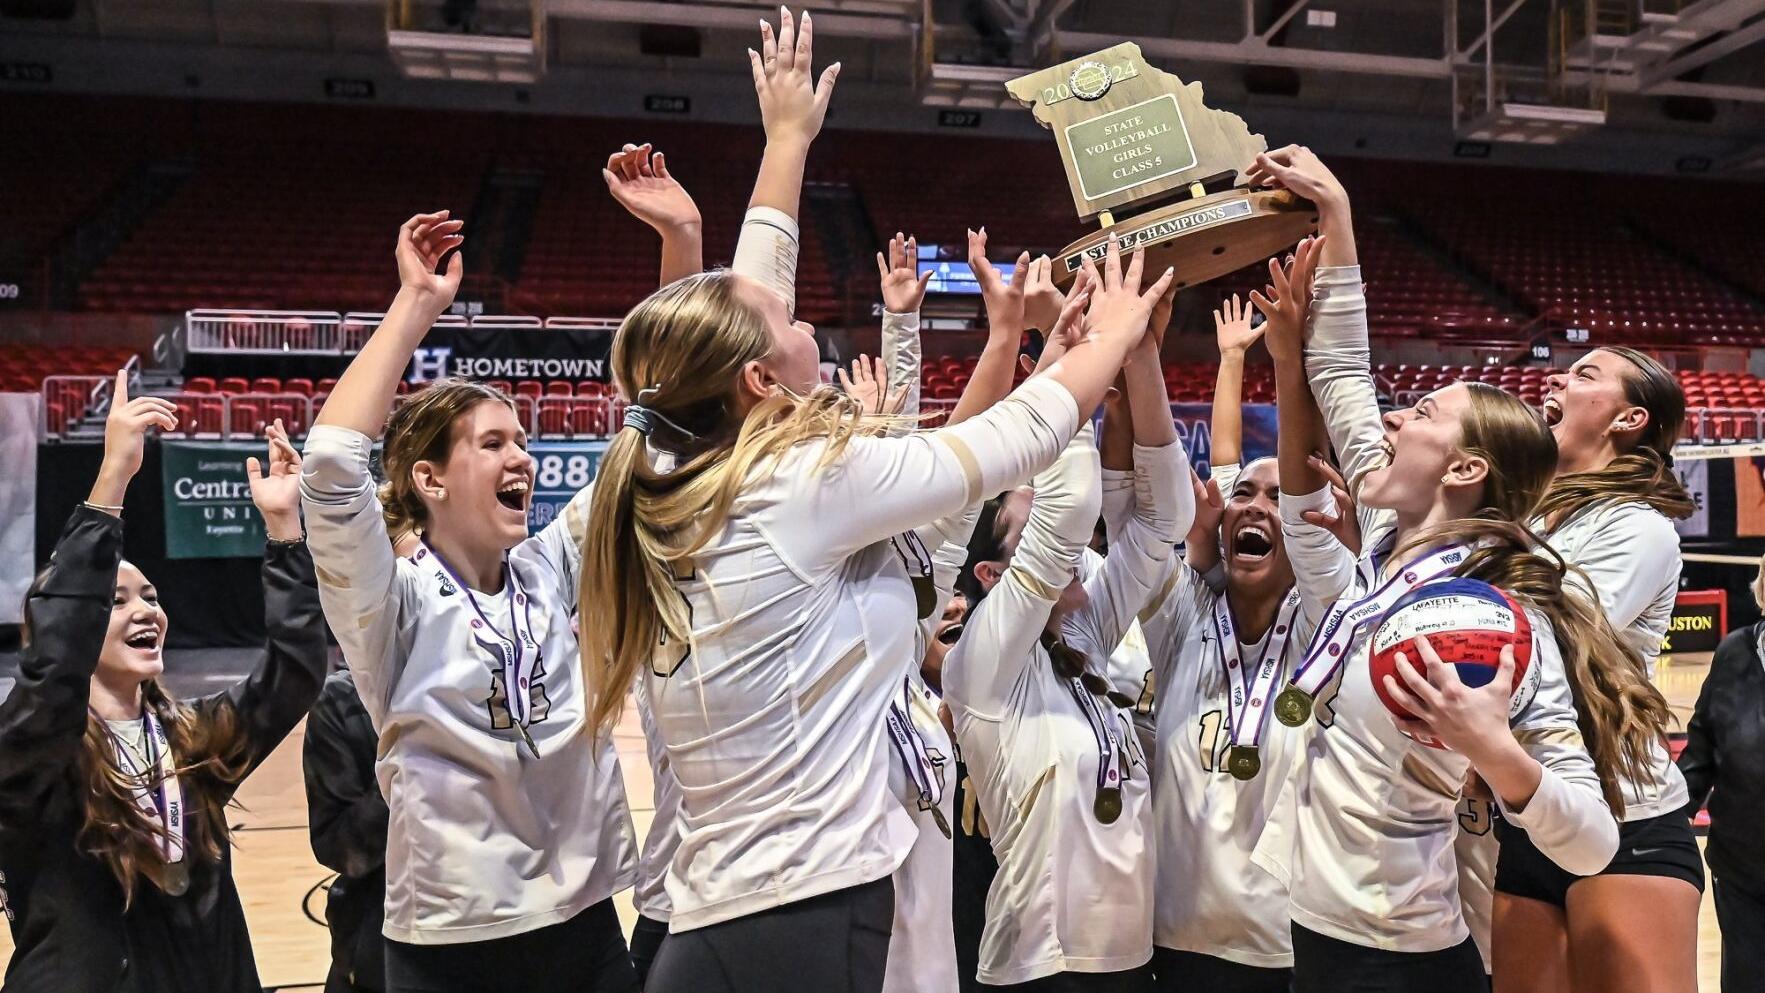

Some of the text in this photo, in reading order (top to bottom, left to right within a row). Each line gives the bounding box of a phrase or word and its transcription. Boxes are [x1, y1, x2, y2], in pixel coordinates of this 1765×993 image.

[1111, 61, 1138, 81] 24
[1044, 83, 1070, 103] 20
[1104, 116, 1144, 136] STATE
[1084, 124, 1171, 157] VOLLEYBALL
[1114, 144, 1153, 163] GIRLS
[1112, 157, 1164, 179] CLASS 5
[1089, 207, 1226, 260] STTE CHAMPIONS
[455, 358, 604, 378] HOMETOWN
[1348, 602, 1382, 623] MSHSAA
[1412, 596, 1459, 611] LAFAYETTE
[1322, 609, 1345, 641] MSHSAA
[1667, 616, 1712, 631] USTON
[1260, 657, 1276, 680] MSHSAA
[169, 801, 180, 828] MSHSAA
